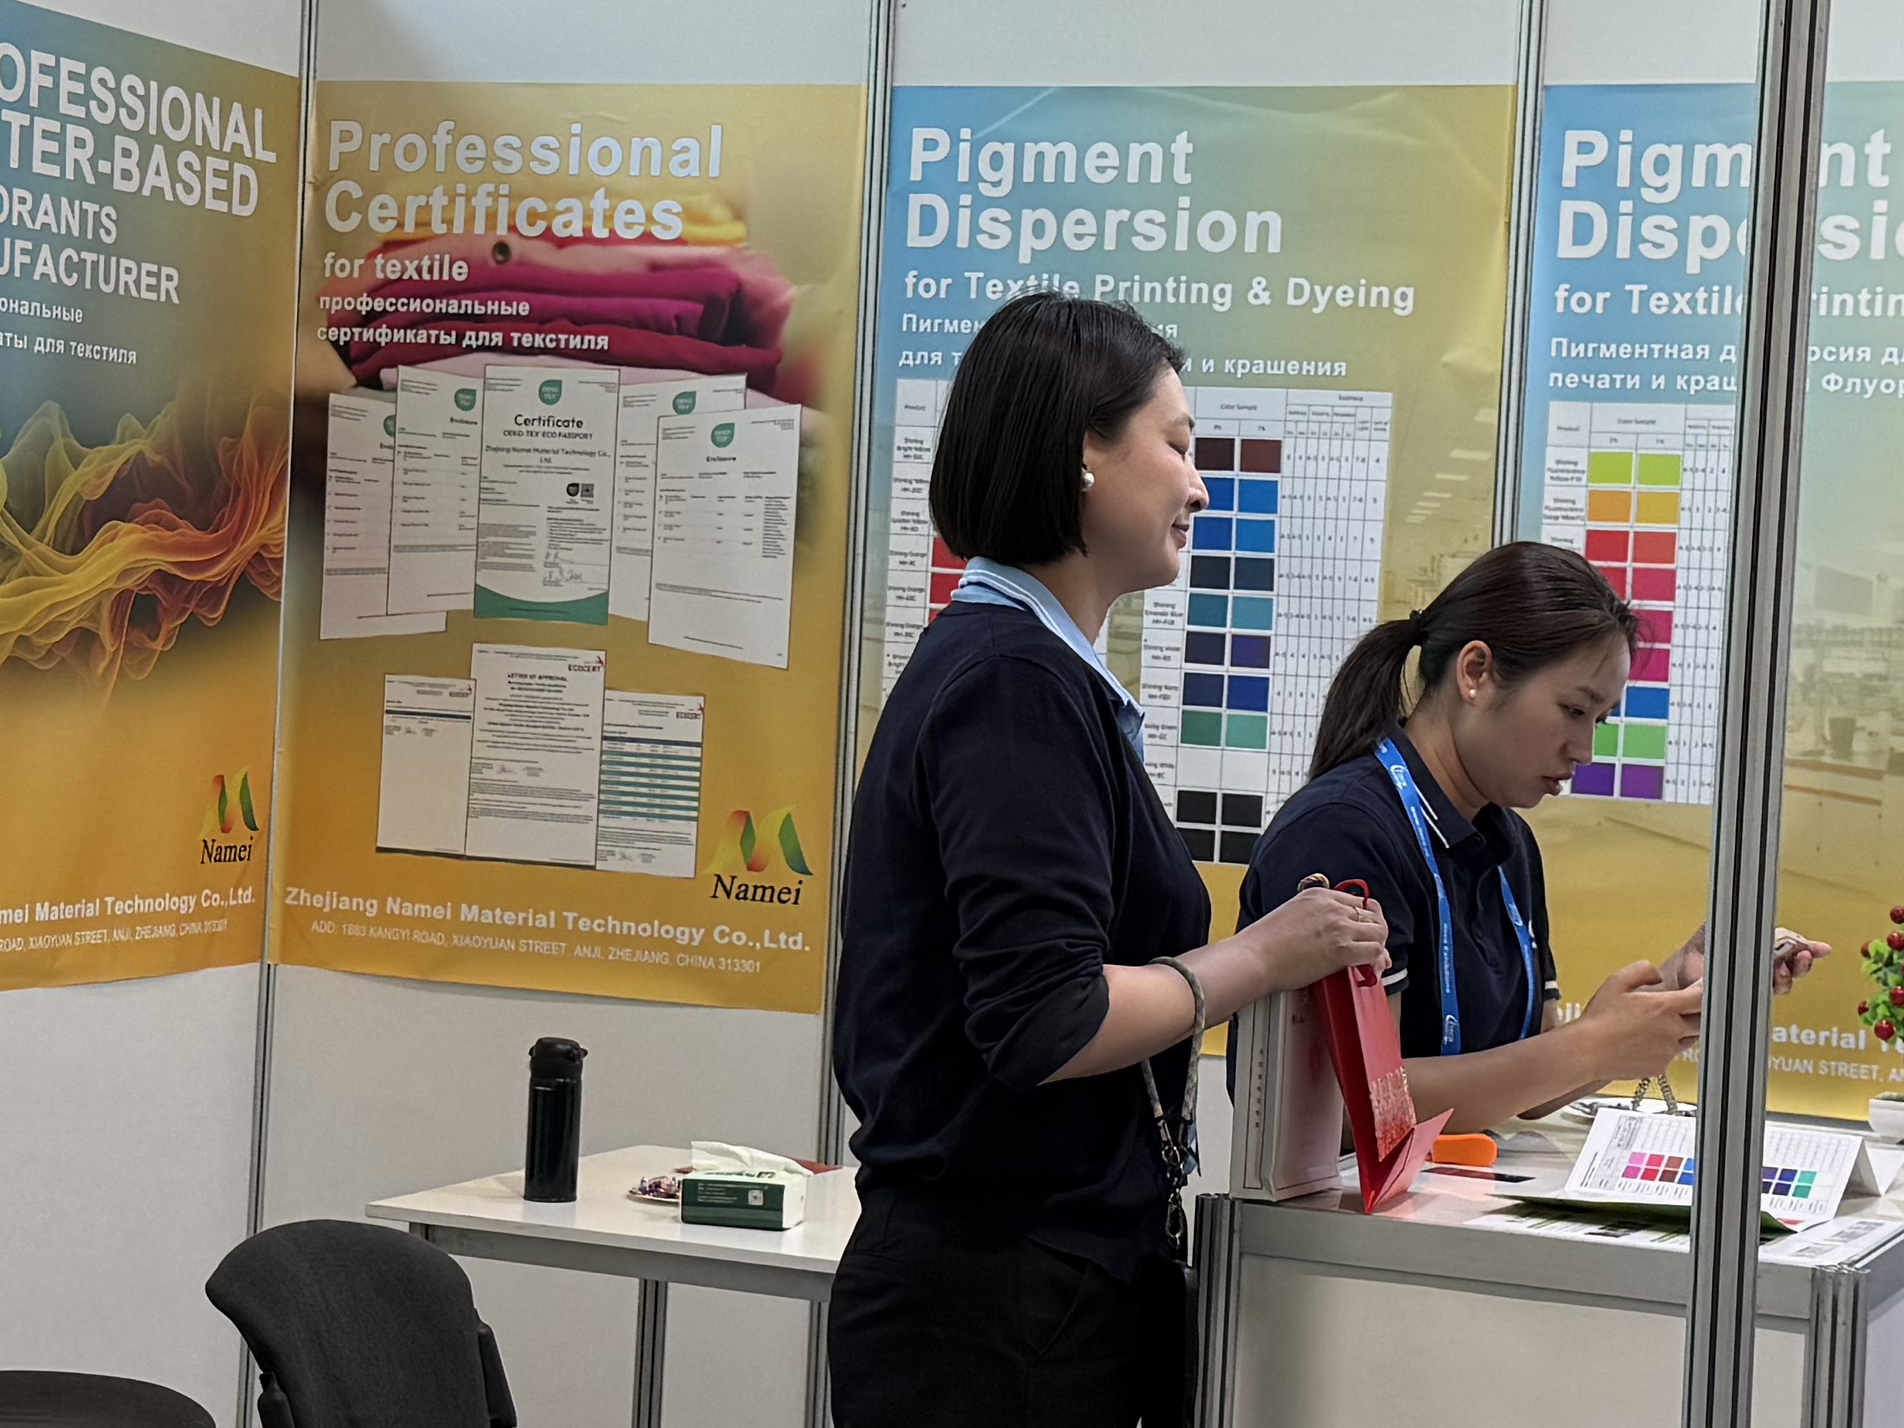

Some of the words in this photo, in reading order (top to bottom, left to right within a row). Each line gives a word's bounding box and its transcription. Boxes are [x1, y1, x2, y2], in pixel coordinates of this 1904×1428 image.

[329, 119, 722, 178] Professional
[908, 127, 1195, 197] Pigment
[1561, 128, 1892, 204] Pigmnt
[324, 180, 684, 240] Certificates
[905, 193, 1283, 263] Dispersion
[324, 252, 365, 279] for
[374, 252, 469, 282] textile
[319, 294, 531, 317] профессиональные
[905, 270, 952, 299] for
[1095, 274, 1233, 313] Printing
[1247, 278, 1271, 306] &
[1286, 278, 1415, 315] Dyeing
[1554, 284, 1610, 315] for
[34, 334, 64, 355] для
[70, 339, 137, 365] текстиля
[317, 324, 456, 347] сертификаты
[463, 329, 503, 349] для
[510, 331, 609, 351] текстиля
[1550, 337, 1711, 361] Пигментная
[899, 347, 942, 368] для
[1224, 355, 1347, 377] крашения
[1548, 369, 1641, 392] печати
[1650, 371, 1665, 389] и
[514, 414, 584, 429] Certificate
[200, 836, 253, 864] Namei
[710, 873, 803, 905] Namei
[35, 897, 99, 921] Material
[104, 893, 196, 916] Technology
[285, 887, 378, 917] Zhejiang
[386, 897, 451, 920] Namei
[460, 903, 555, 929] Material
[563, 912, 705, 946] Technology
[713, 926, 811, 951] Co.,Ltd.
[1772, 1024, 1866, 1050] aterial
